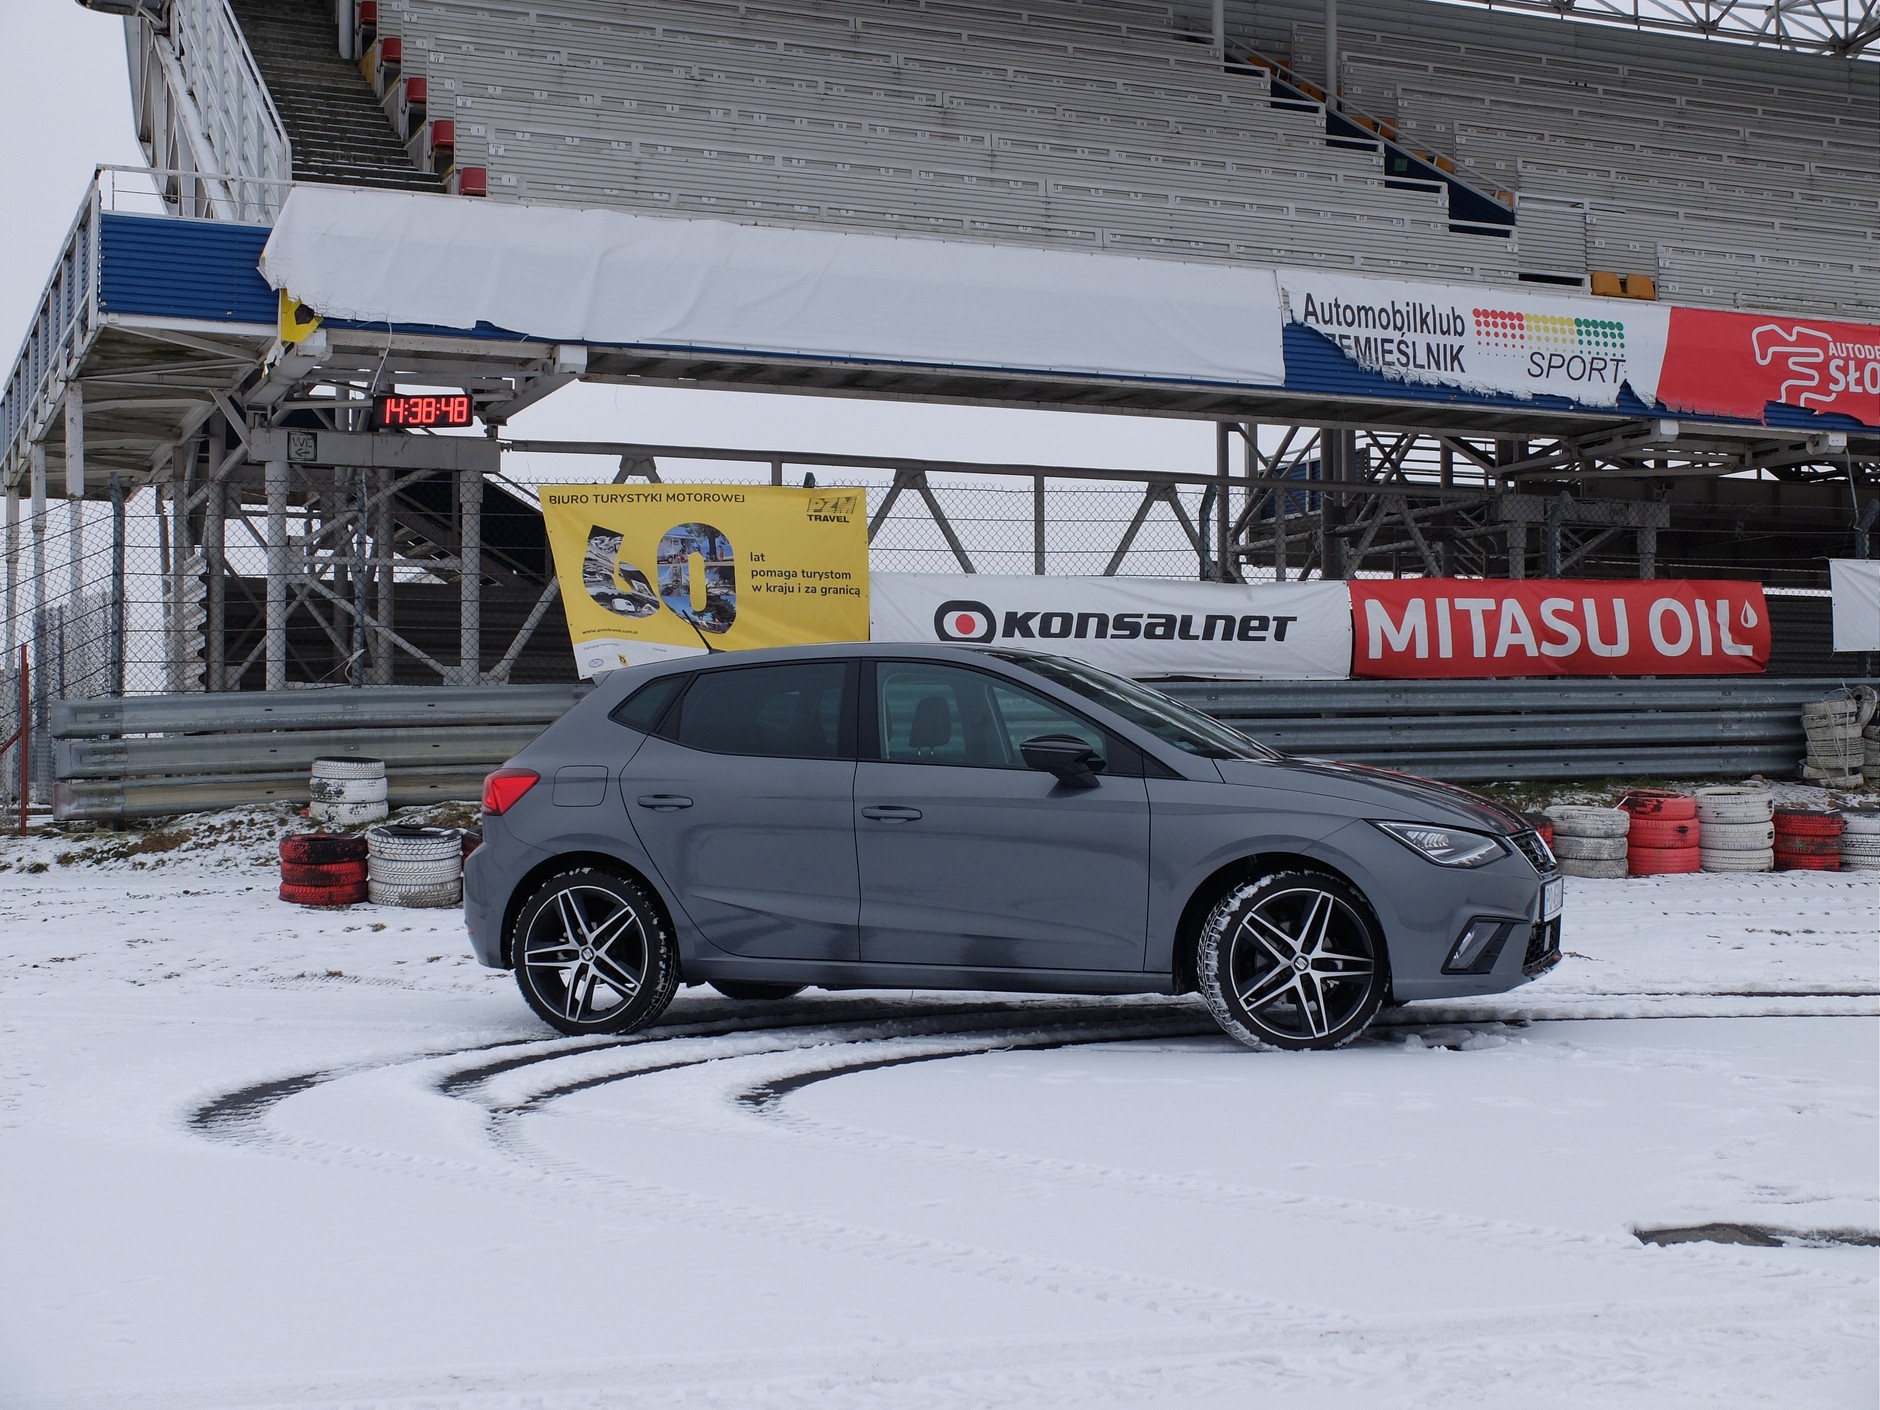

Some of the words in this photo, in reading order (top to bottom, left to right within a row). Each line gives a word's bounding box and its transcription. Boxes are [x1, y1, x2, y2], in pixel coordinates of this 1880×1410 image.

[1304, 293, 1465, 337] Automobilklub
[1527, 351, 1627, 385] SPORT
[385, 397, 468, 424] 14:38:48
[549, 495, 589, 505] BIURO
[593, 493, 662, 504] TURYSTYKI
[666, 493, 746, 503] MOTOROWEJ
[807, 514, 850, 523] TRAVEL
[750, 552, 765, 563] lat
[751, 568, 798, 582] pomaga
[801, 569, 851, 581] turystom
[752, 585, 763, 593] w
[766, 582, 795, 596] kraju
[804, 586, 817, 594] za
[820, 584, 861, 598] granicą
[1364, 598, 1631, 660] MITASU
[1648, 598, 1754, 657] OIL
